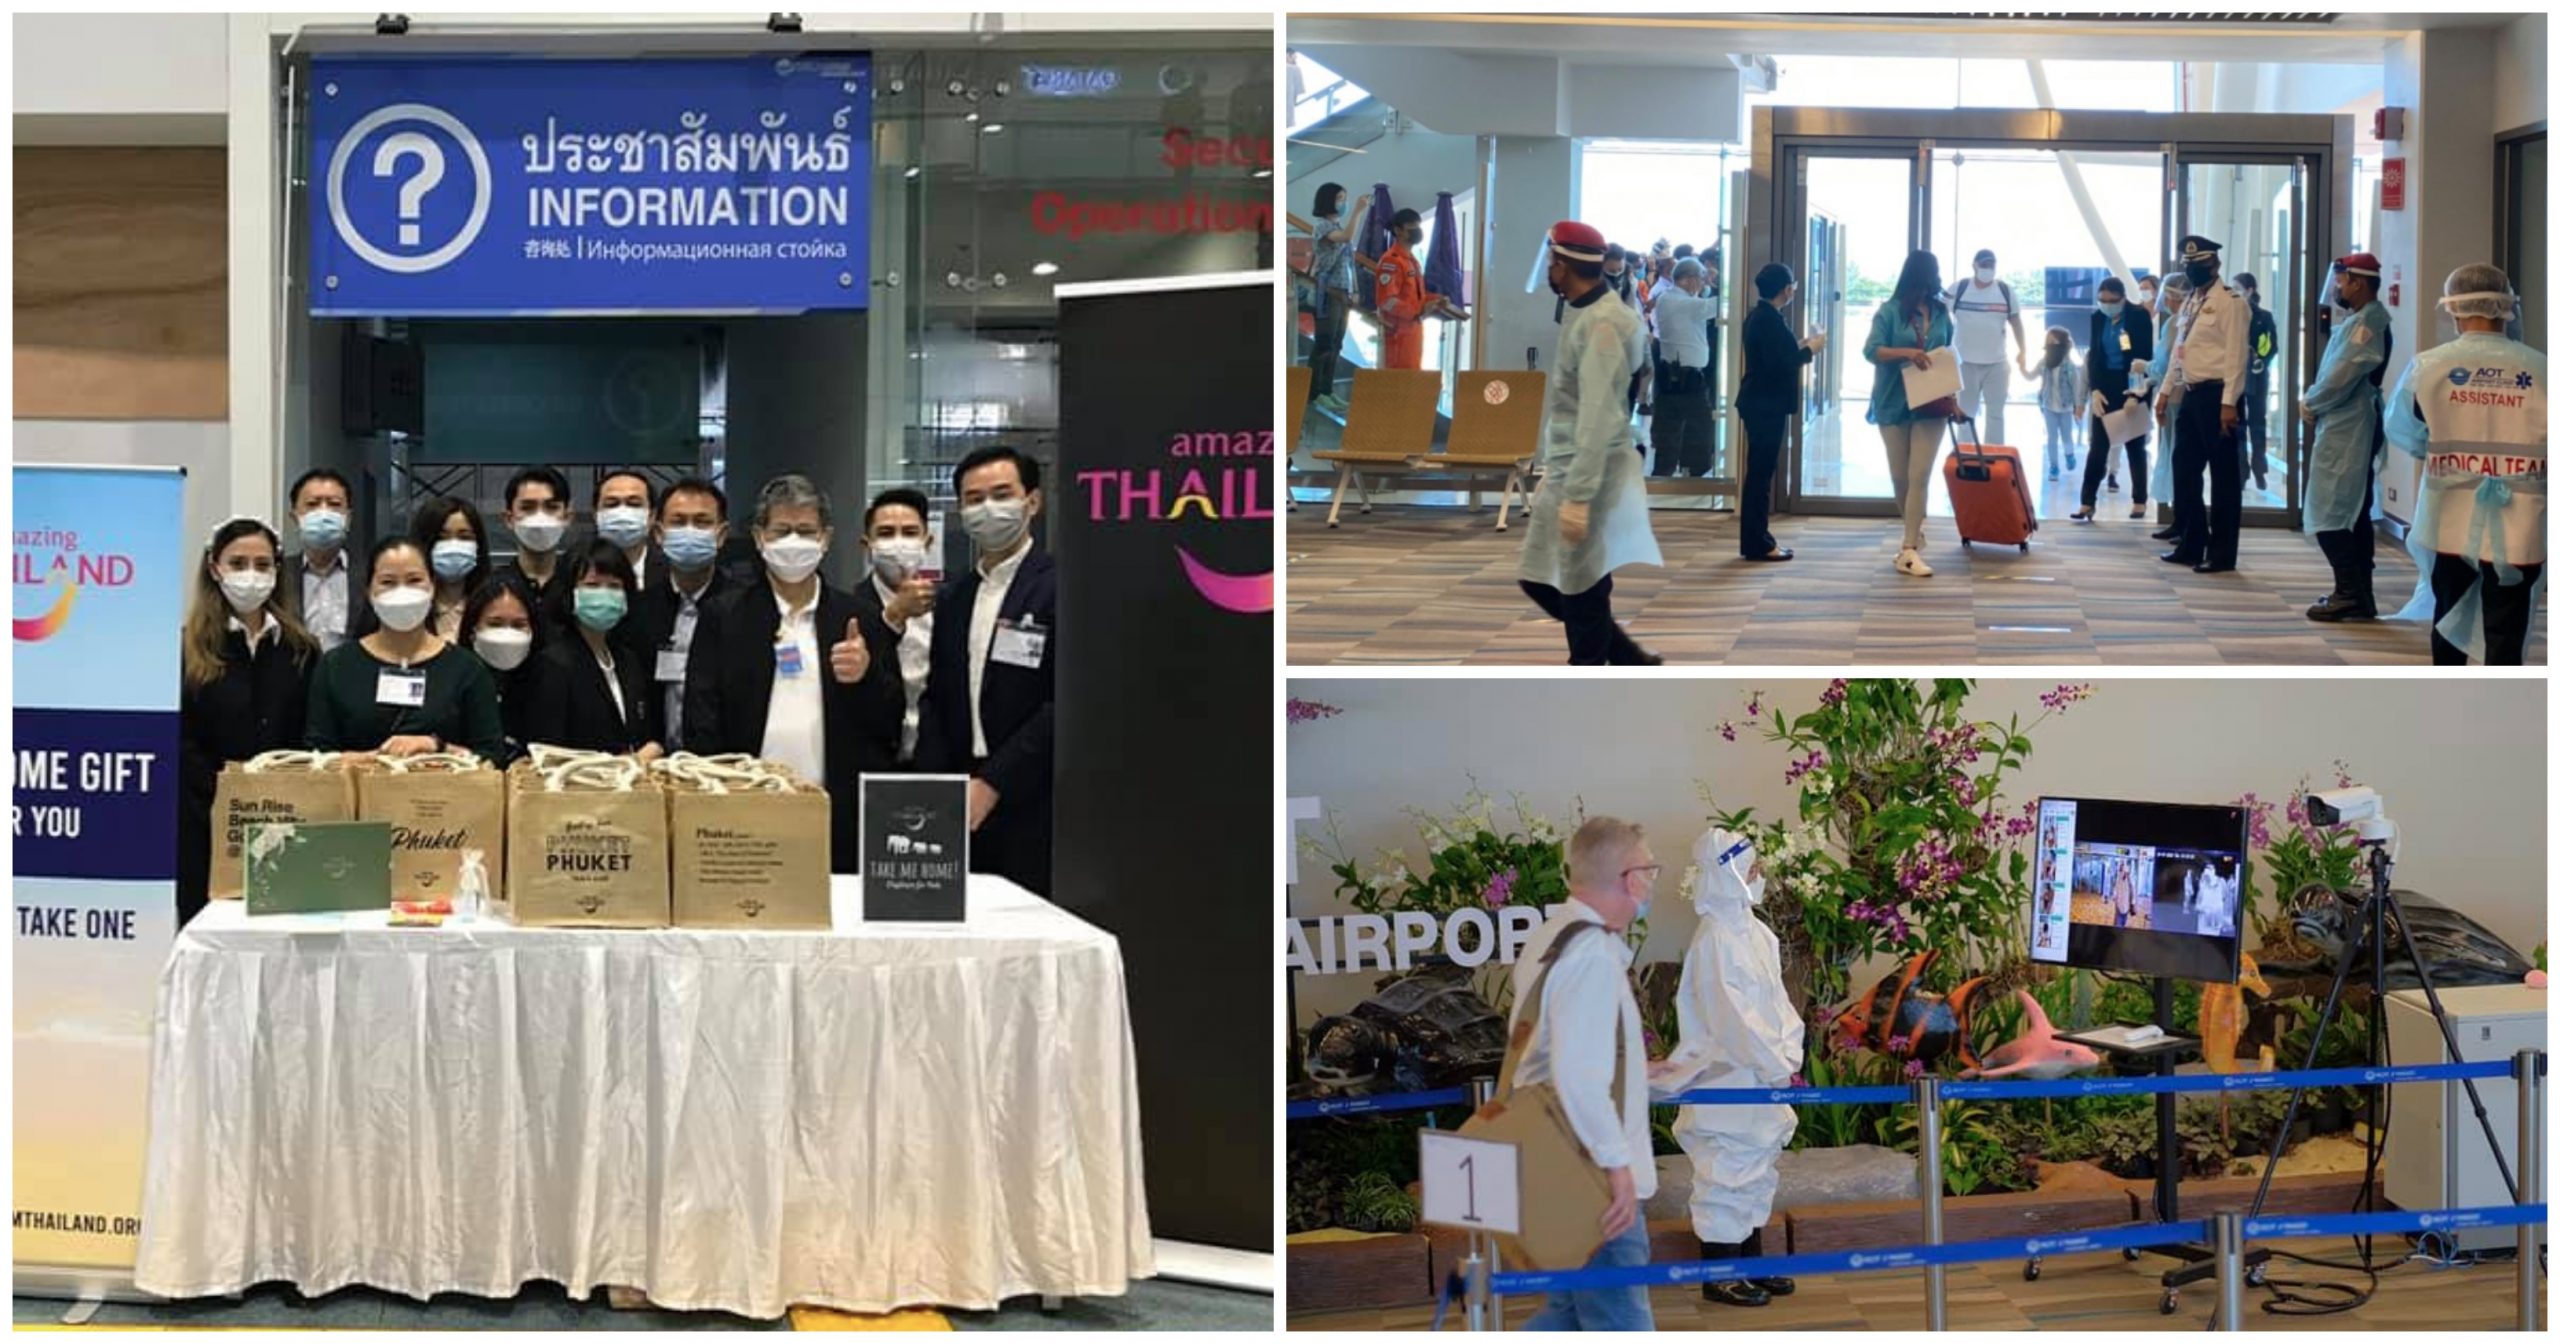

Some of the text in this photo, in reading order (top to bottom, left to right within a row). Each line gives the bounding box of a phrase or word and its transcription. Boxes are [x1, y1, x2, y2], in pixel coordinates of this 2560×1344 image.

[523, 106, 851, 173] ประชาสัมพันธ์
[528, 186, 848, 227] INFORMATION
[588, 238, 847, 264] Информационная стойка
[2475, 367, 2504, 378] AOT
[2449, 390, 2525, 408] ASSISTANT
[1170, 431, 1273, 456] amaz
[1077, 468, 1273, 520] THAIL
[13, 750, 156, 792] ME GIFT
[31, 805, 81, 838] YOU
[546, 854, 633, 872] PHUKET
[17, 906, 136, 940] TAKE ONE
[1459, 1153, 1483, 1223] 1
